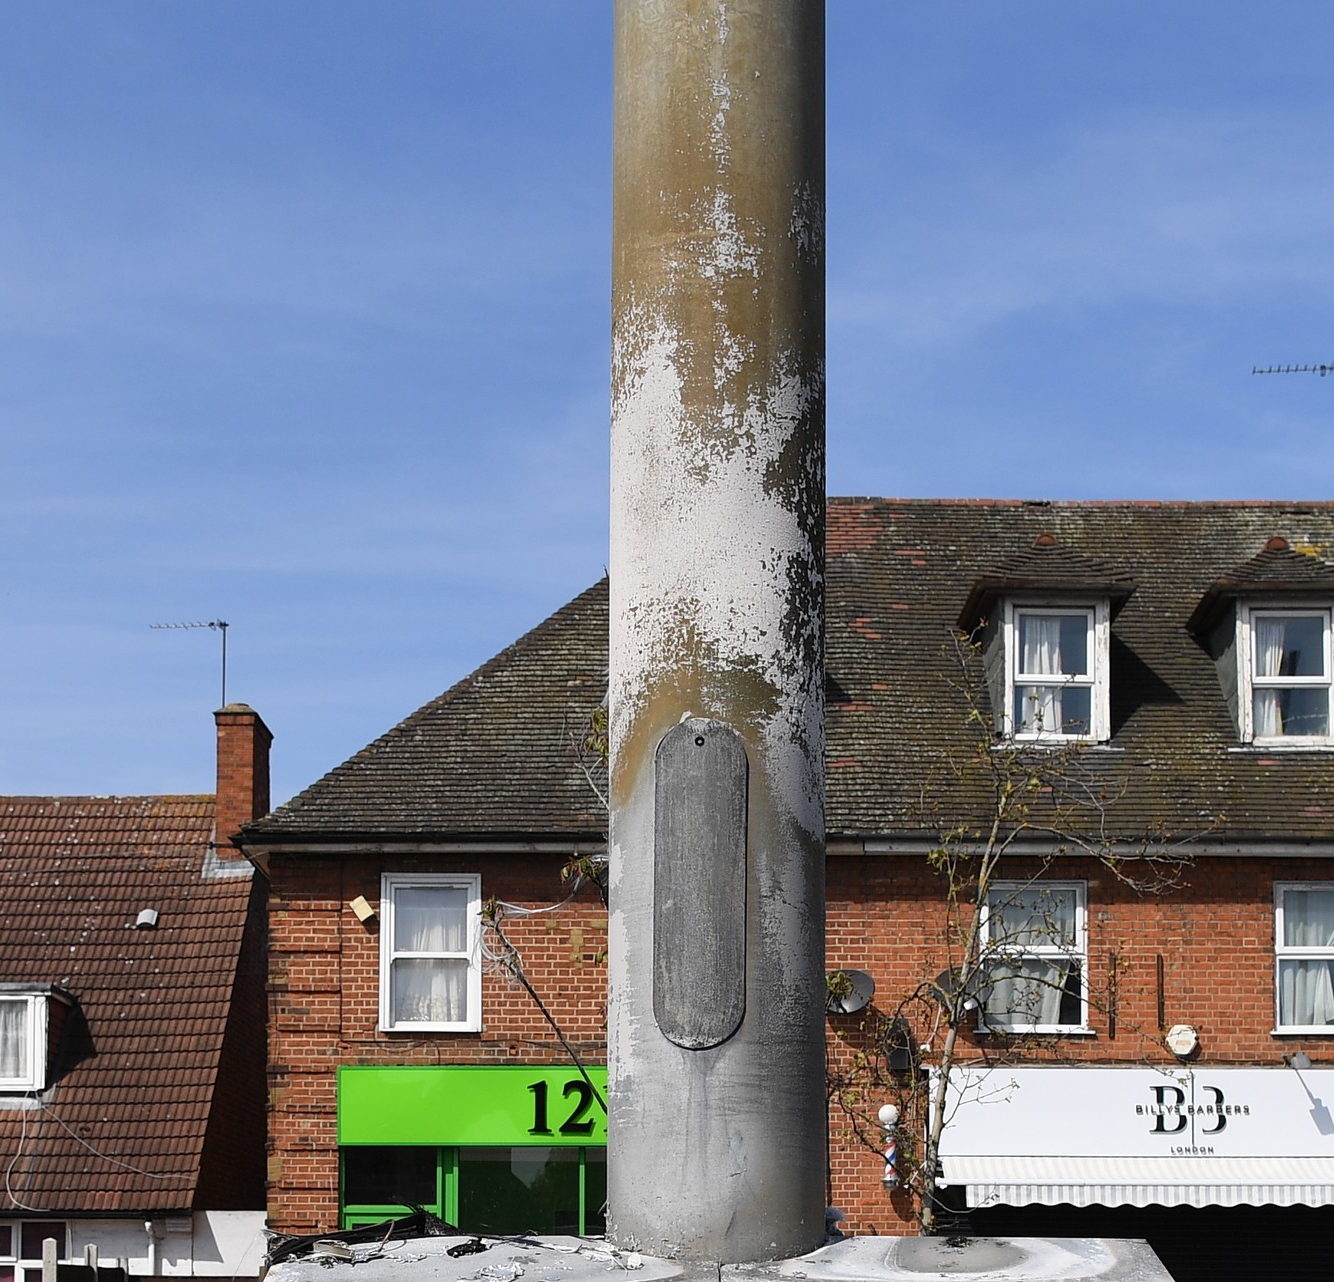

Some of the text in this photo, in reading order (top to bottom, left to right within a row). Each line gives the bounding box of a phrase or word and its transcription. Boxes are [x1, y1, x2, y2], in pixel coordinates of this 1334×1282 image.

[527, 1080, 607, 1136] 12
[1136, 1105, 1250, 1115] BILLYS BARBERS
[1170, 1146, 1215, 1155] LONDON
